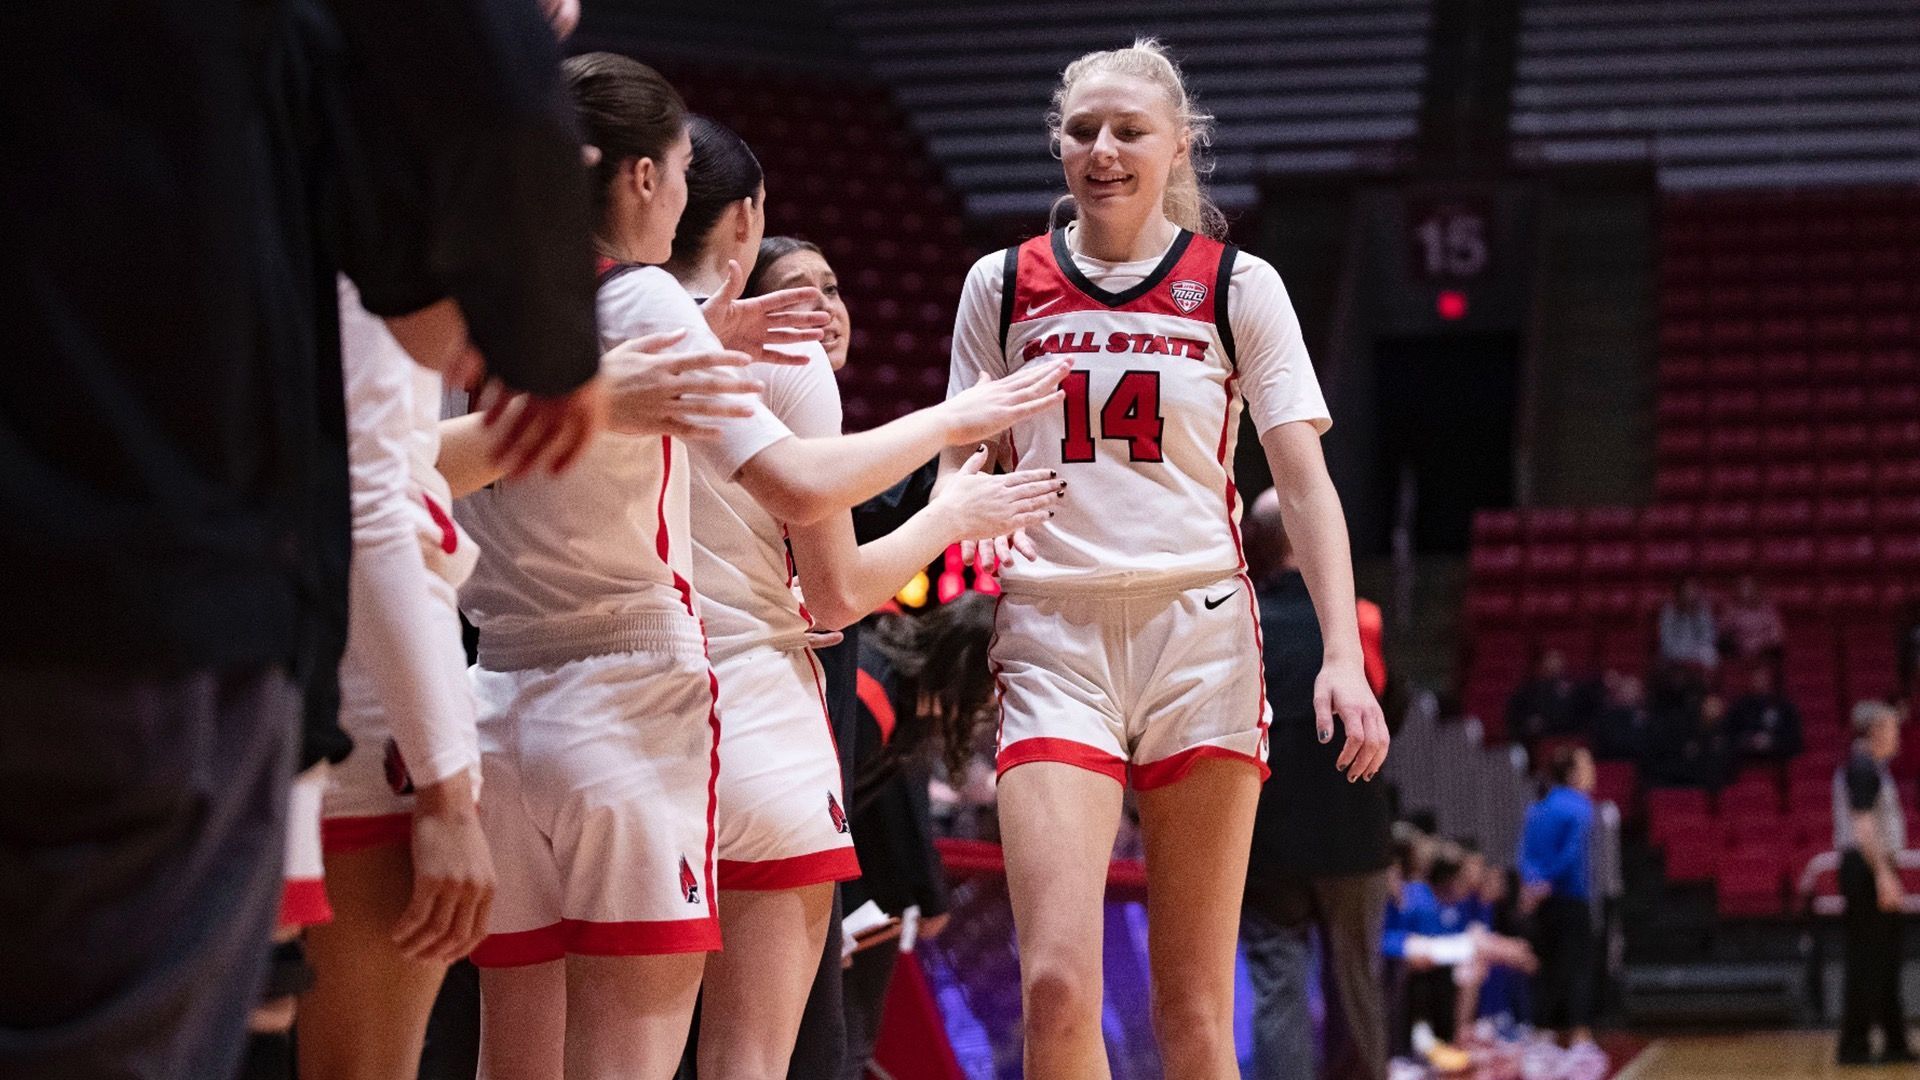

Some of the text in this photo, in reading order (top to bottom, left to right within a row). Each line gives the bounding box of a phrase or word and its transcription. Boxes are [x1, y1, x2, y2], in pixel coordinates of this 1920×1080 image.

[1416, 216, 1487, 273] 15
[1173, 289, 1204, 300] MAC
[1106, 332, 1209, 361] STATE
[1058, 370, 1164, 463] 14
